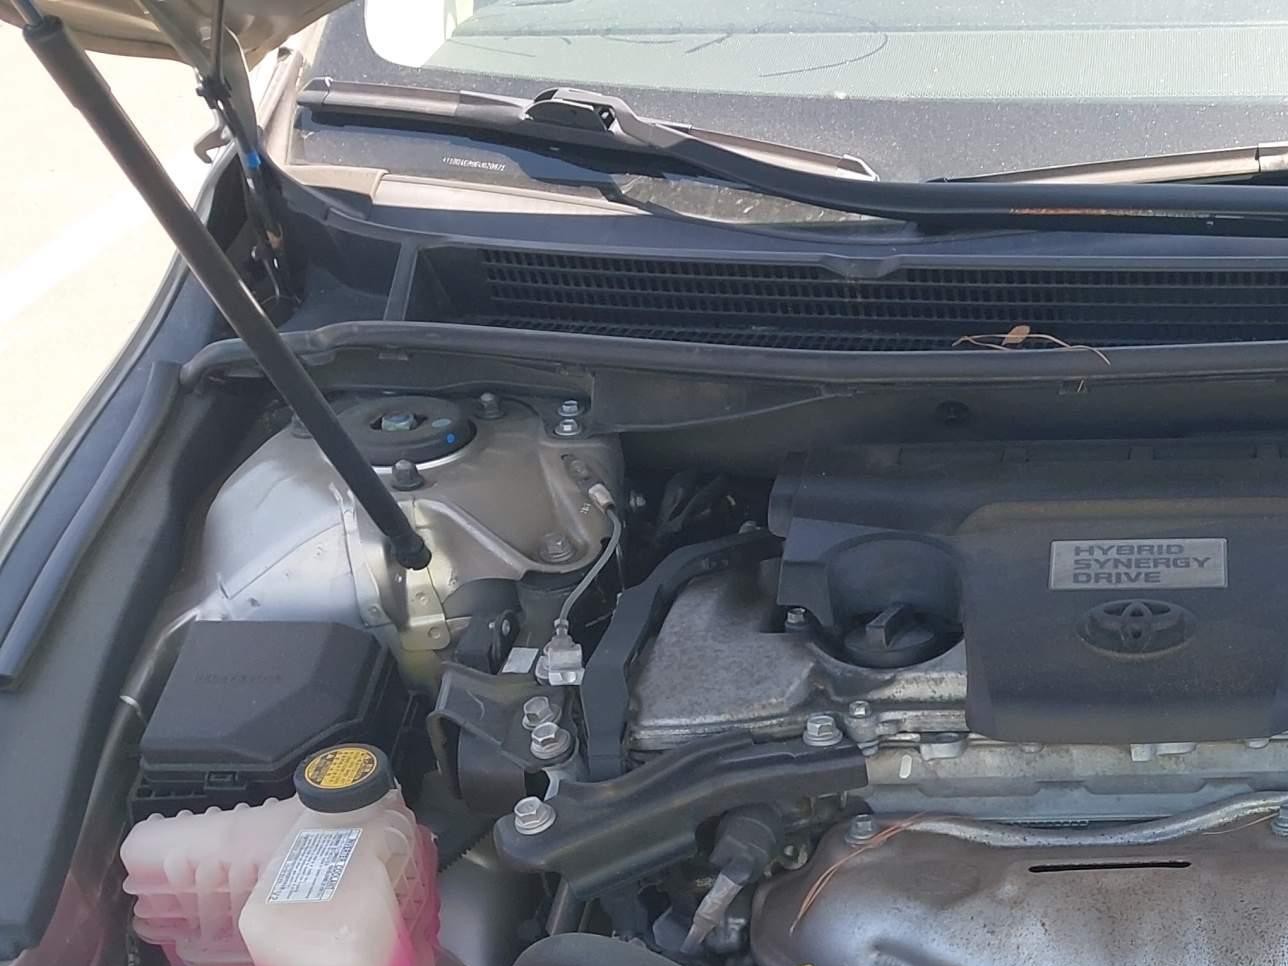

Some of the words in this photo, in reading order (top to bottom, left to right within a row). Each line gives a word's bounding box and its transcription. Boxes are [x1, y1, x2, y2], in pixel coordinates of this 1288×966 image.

[1074, 544, 1184, 556] HYBRID
[1073, 557, 1212, 570] SYNERGY
[1072, 571, 1161, 584] DRIVE
